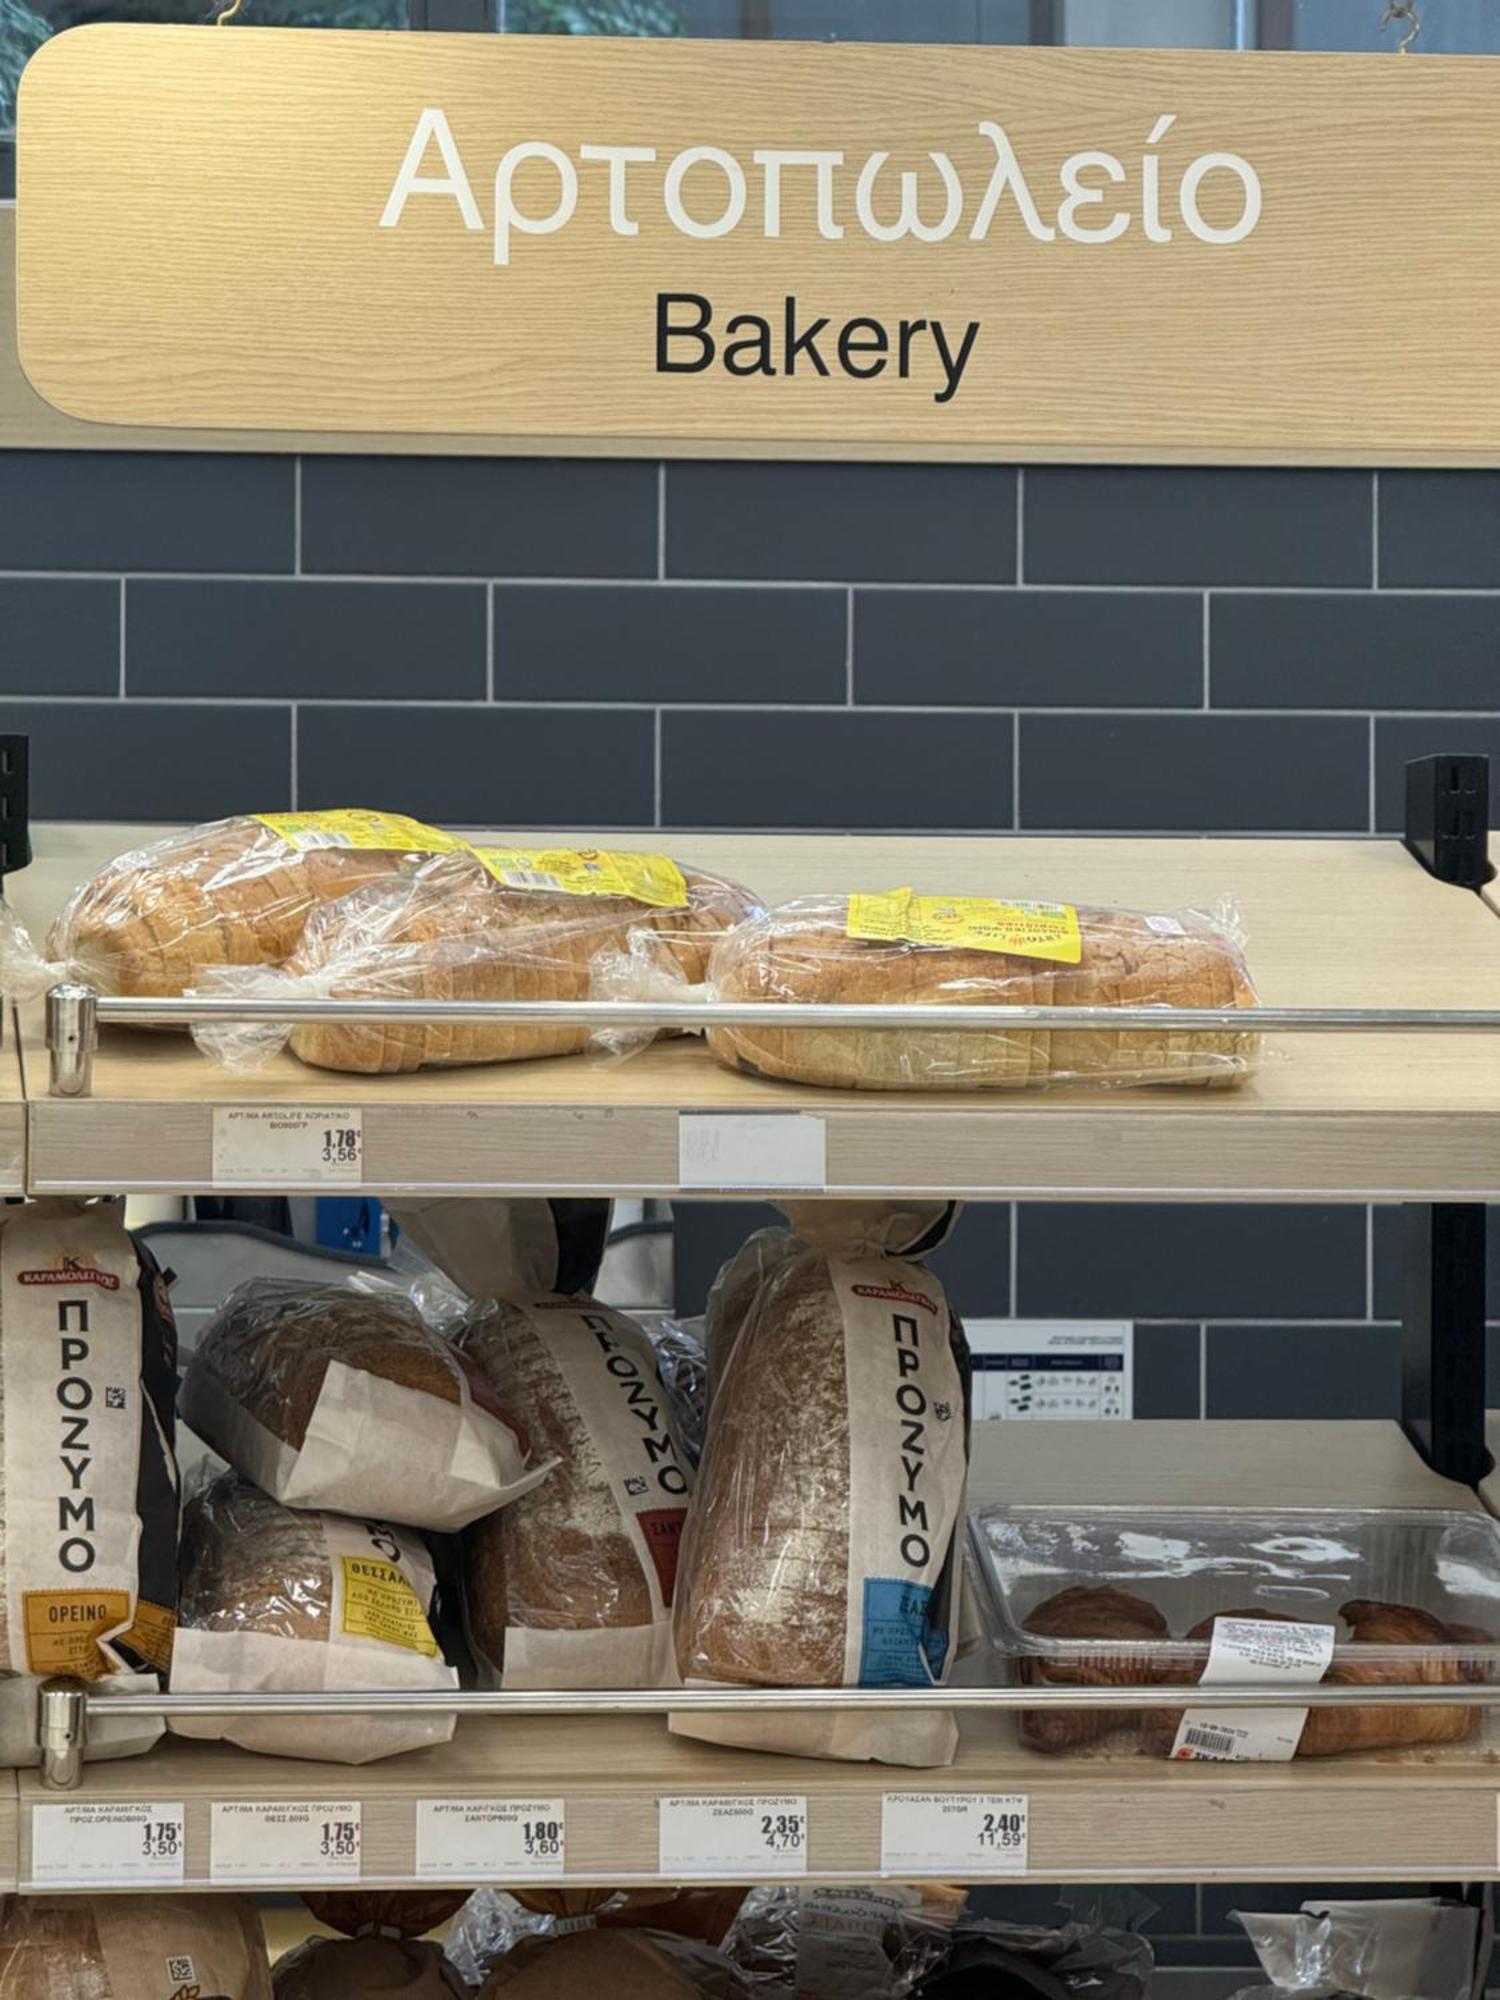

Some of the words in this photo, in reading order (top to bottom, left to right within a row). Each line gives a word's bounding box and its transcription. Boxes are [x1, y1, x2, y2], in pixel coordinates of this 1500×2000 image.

[380, 107, 1262, 266] Αρτοπωλείο
[654, 292, 980, 402] Bakery
[57, 1300, 96, 1573] ΠΡΟΖΥΜΟ
[893, 1314, 930, 1567] ΠΡΟΖΥΜΟ
[49, 1603, 107, 1622] ΟΡΕΙΝΟ
